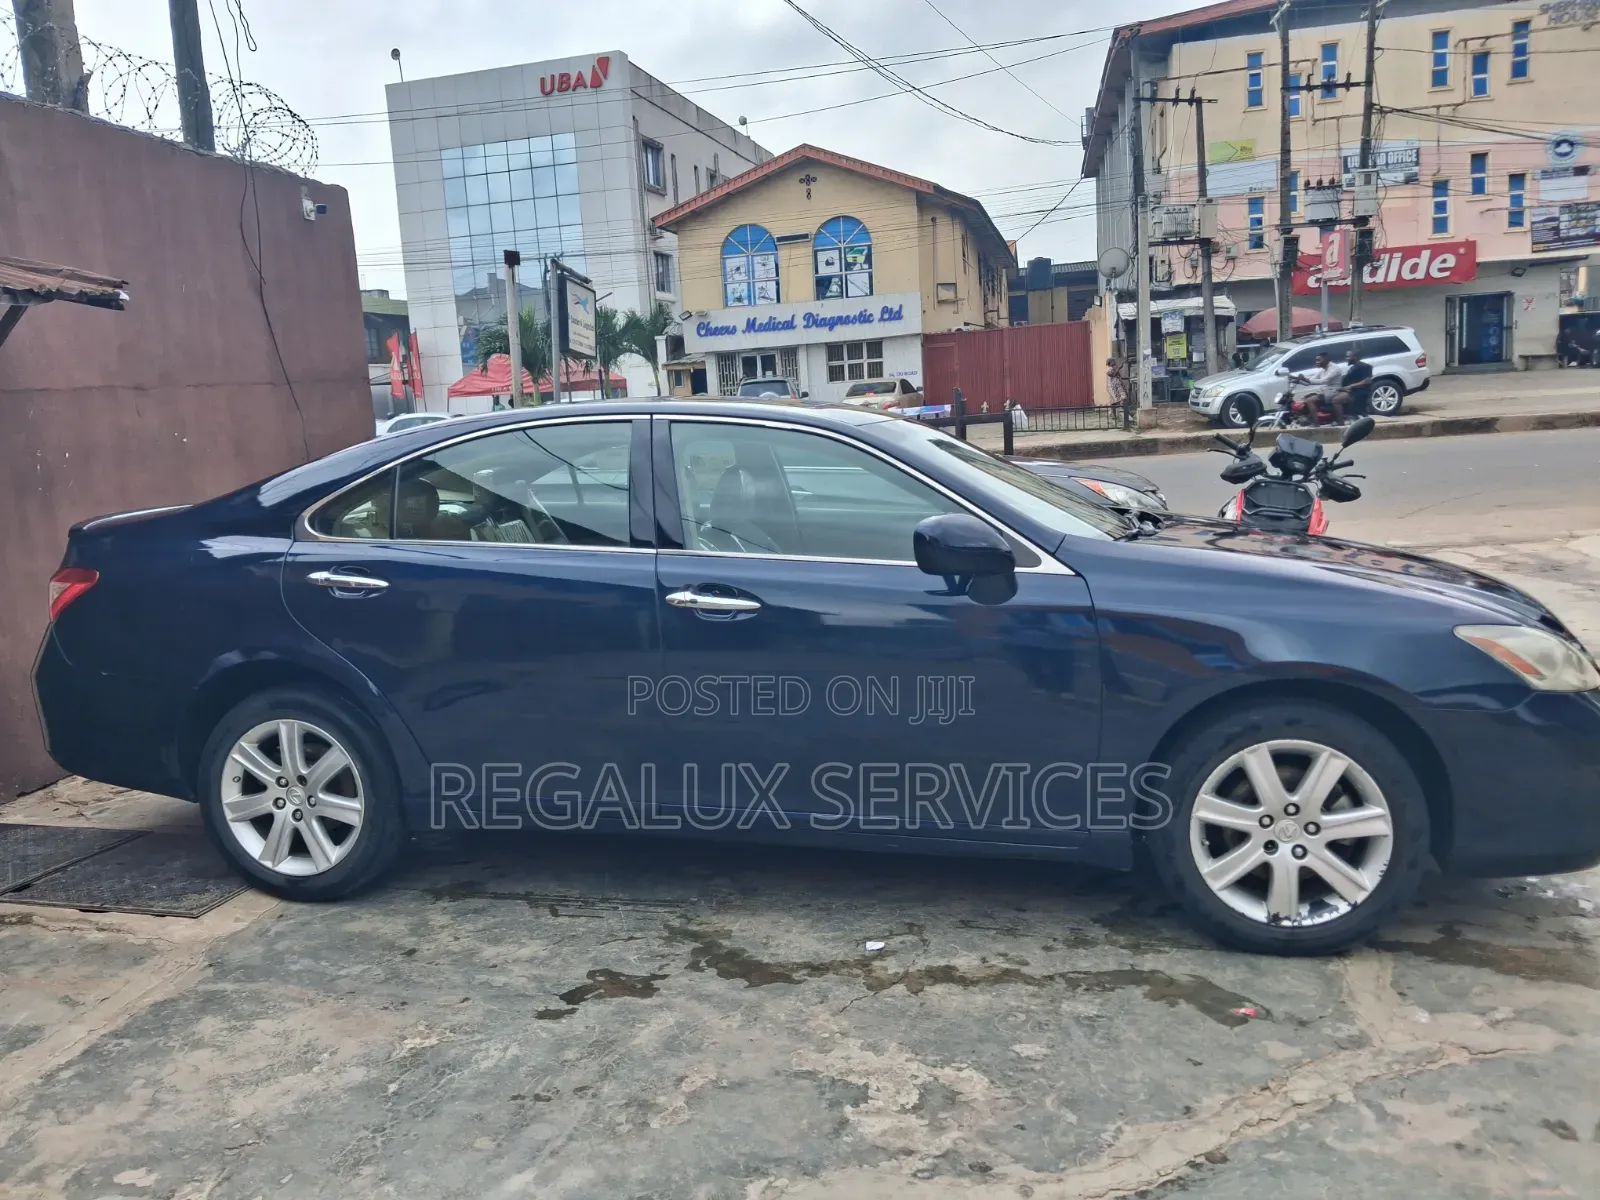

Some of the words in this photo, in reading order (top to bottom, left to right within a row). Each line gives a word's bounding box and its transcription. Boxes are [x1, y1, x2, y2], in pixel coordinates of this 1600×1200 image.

[1549, 4, 1599, 24] HOUSE
[540, 70, 588, 96] UBA
[1387, 149, 1418, 165] OFFICE
[696, 321, 737, 338] Cheers
[741, 314, 797, 334] Medical
[802, 308, 875, 332] Diagnostic
[878, 303, 904, 322] Ltd
